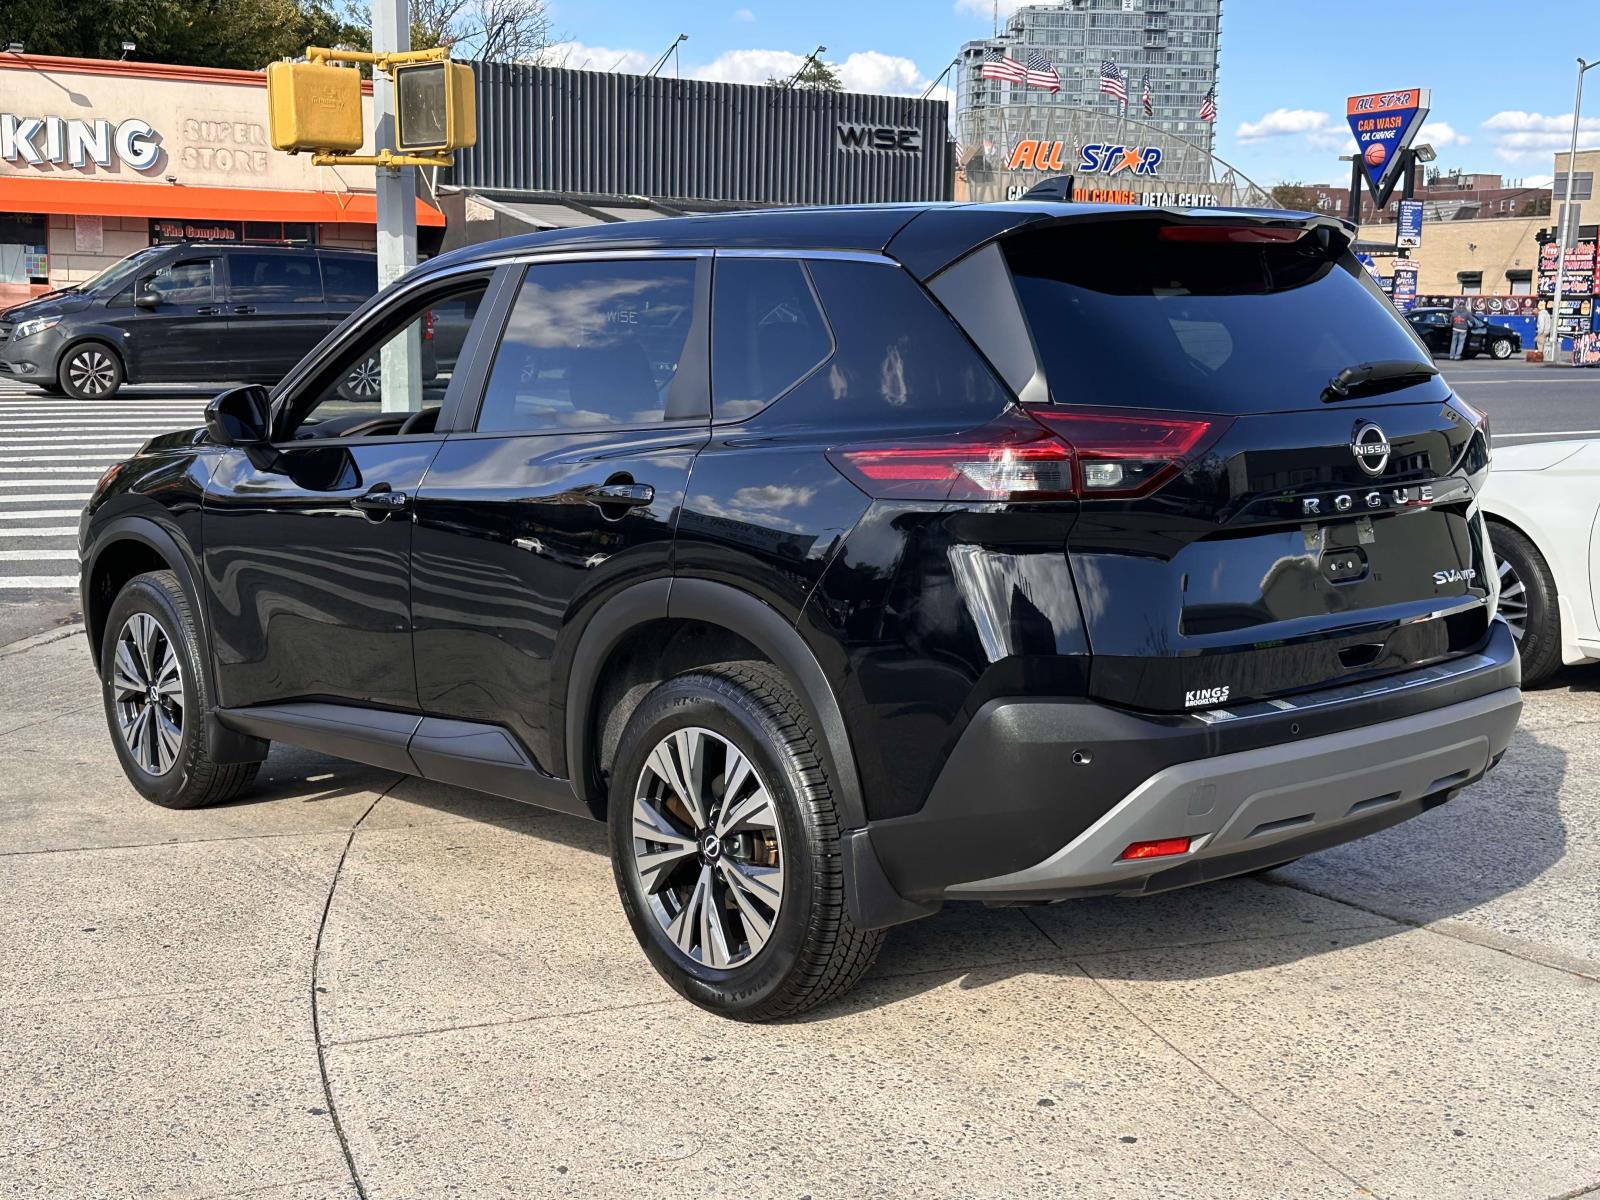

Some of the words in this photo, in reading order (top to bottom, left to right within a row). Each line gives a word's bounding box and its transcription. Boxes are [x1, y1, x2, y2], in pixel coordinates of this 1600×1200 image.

[1355, 97, 1375, 111] ALL
[183, 118, 267, 146] SUPER
[1358, 119, 1375, 131] CAR
[1376, 116, 1402, 129] WASH
[1, 113, 159, 170] KING
[837, 125, 921, 152] WISE
[181, 146, 268, 173] STORE
[1008, 140, 1064, 170] ALL
[1092, 190, 1136, 205] CHANGE
[1142, 192, 1178, 206] DETAIL
[1179, 193, 1217, 207] CENTER
[162, 224, 184, 237] The
[185, 225, 235, 241] Complete
[607, 310, 638, 324] WISE
[1355, 443, 1390, 455] NISSAN
[1302, 485, 1434, 515] ROGUE
[1185, 685, 1230, 701] KINGS
[1218, 695, 1228, 703] NY
